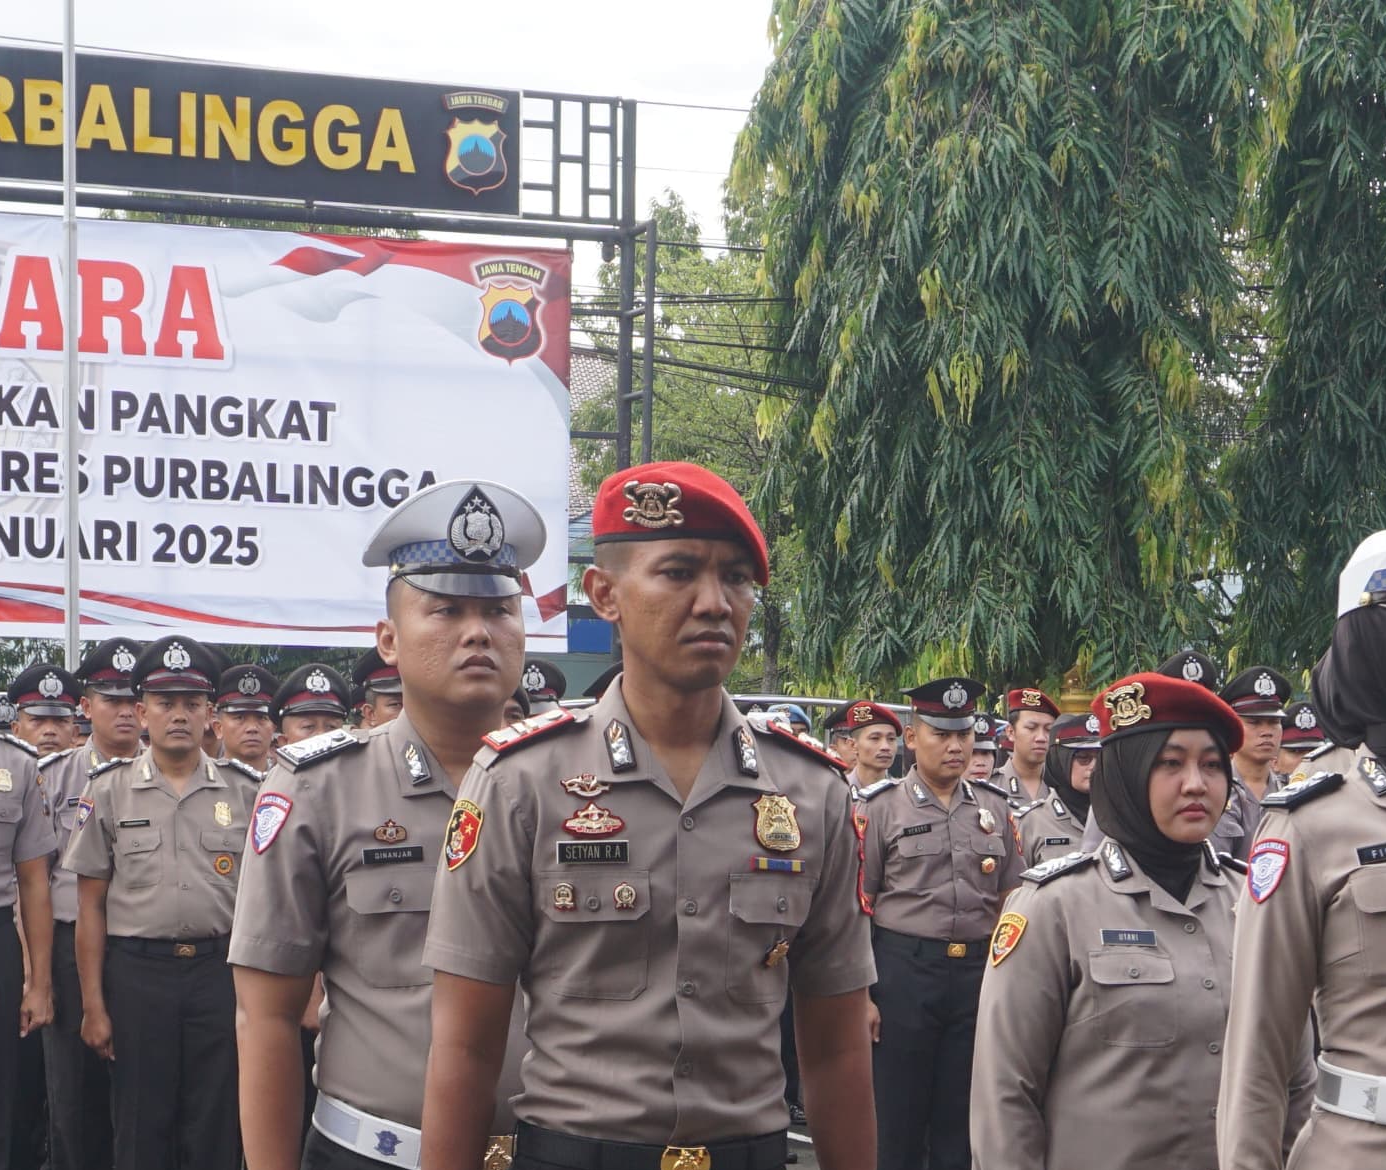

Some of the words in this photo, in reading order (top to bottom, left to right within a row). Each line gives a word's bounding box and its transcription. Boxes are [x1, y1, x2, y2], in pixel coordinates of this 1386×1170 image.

[451, 94, 473, 105] JAWA
[474, 95, 504, 109] TENGAH
[480, 263, 504, 277] JAWA
[506, 262, 541, 279] TENGAH
[112, 391, 337, 442] PANGKAT
[151, 522, 260, 566] 2025
[565, 845, 601, 860] SETYAN
